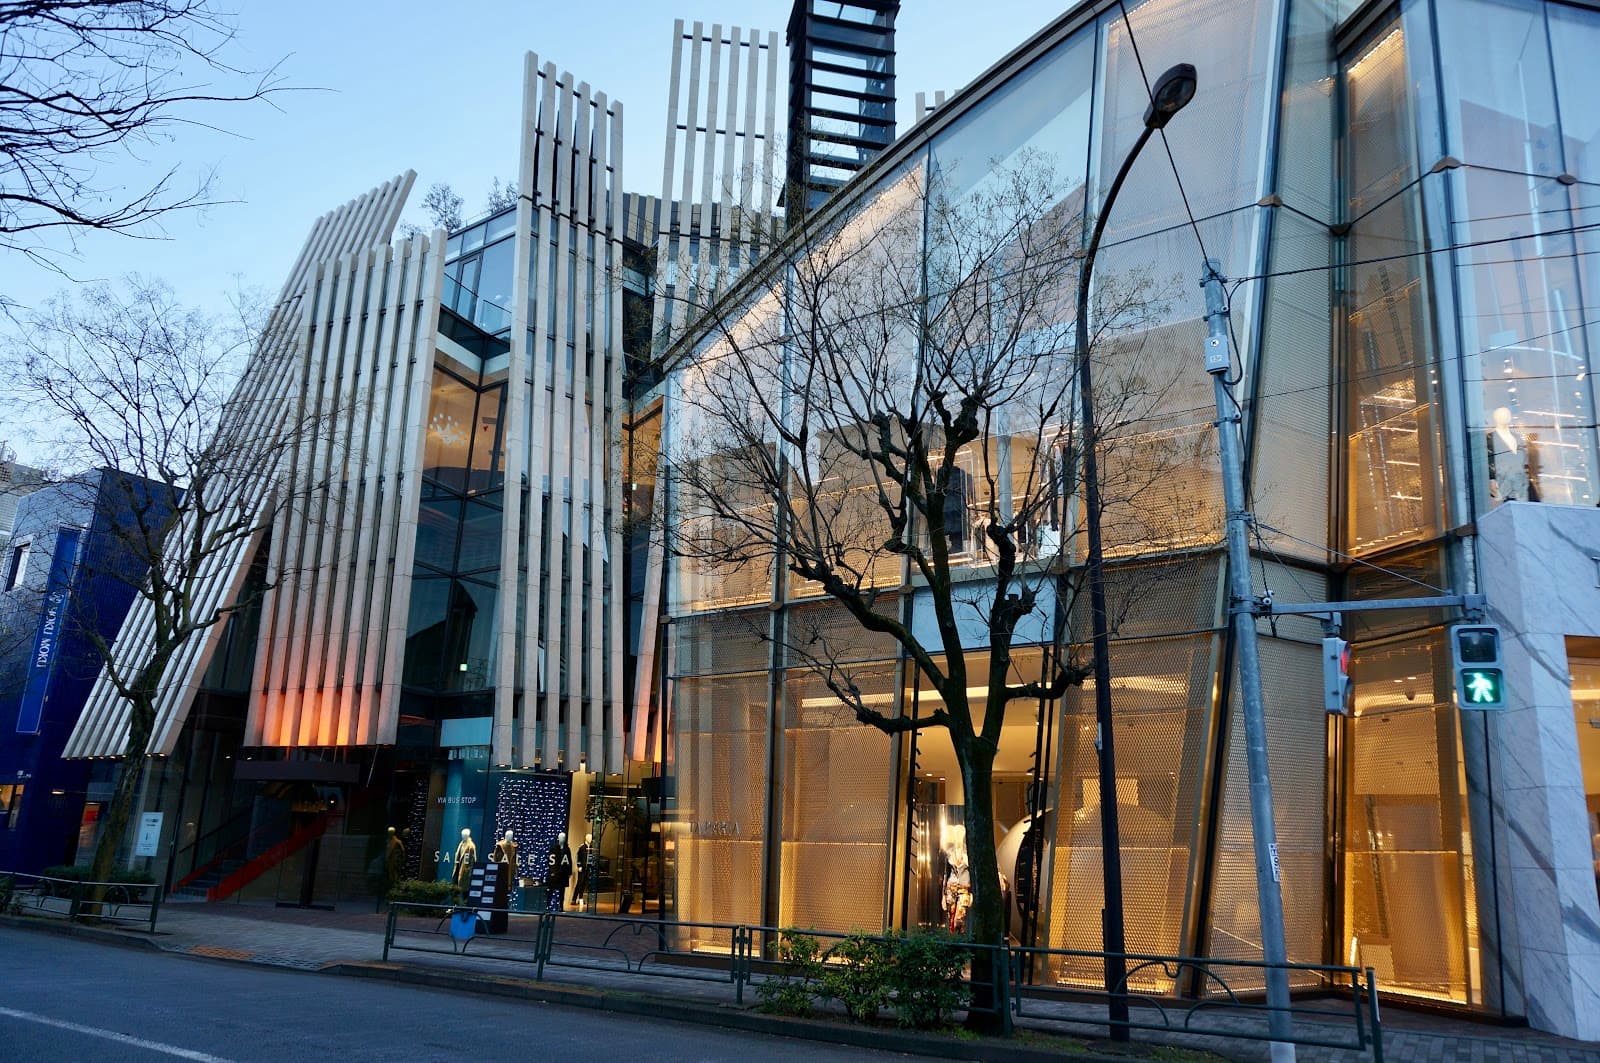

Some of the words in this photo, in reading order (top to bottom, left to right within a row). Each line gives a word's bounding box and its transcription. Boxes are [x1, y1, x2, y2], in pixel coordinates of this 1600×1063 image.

[43, 607, 58, 635] YOKU
[36, 638, 51, 668] MOKU
[437, 796, 446, 804] VIA
[448, 796, 460, 804] BUS
[461, 796, 476, 804] STOP
[434, 850, 470, 865] SALE
[487, 852, 536, 866] SALE
